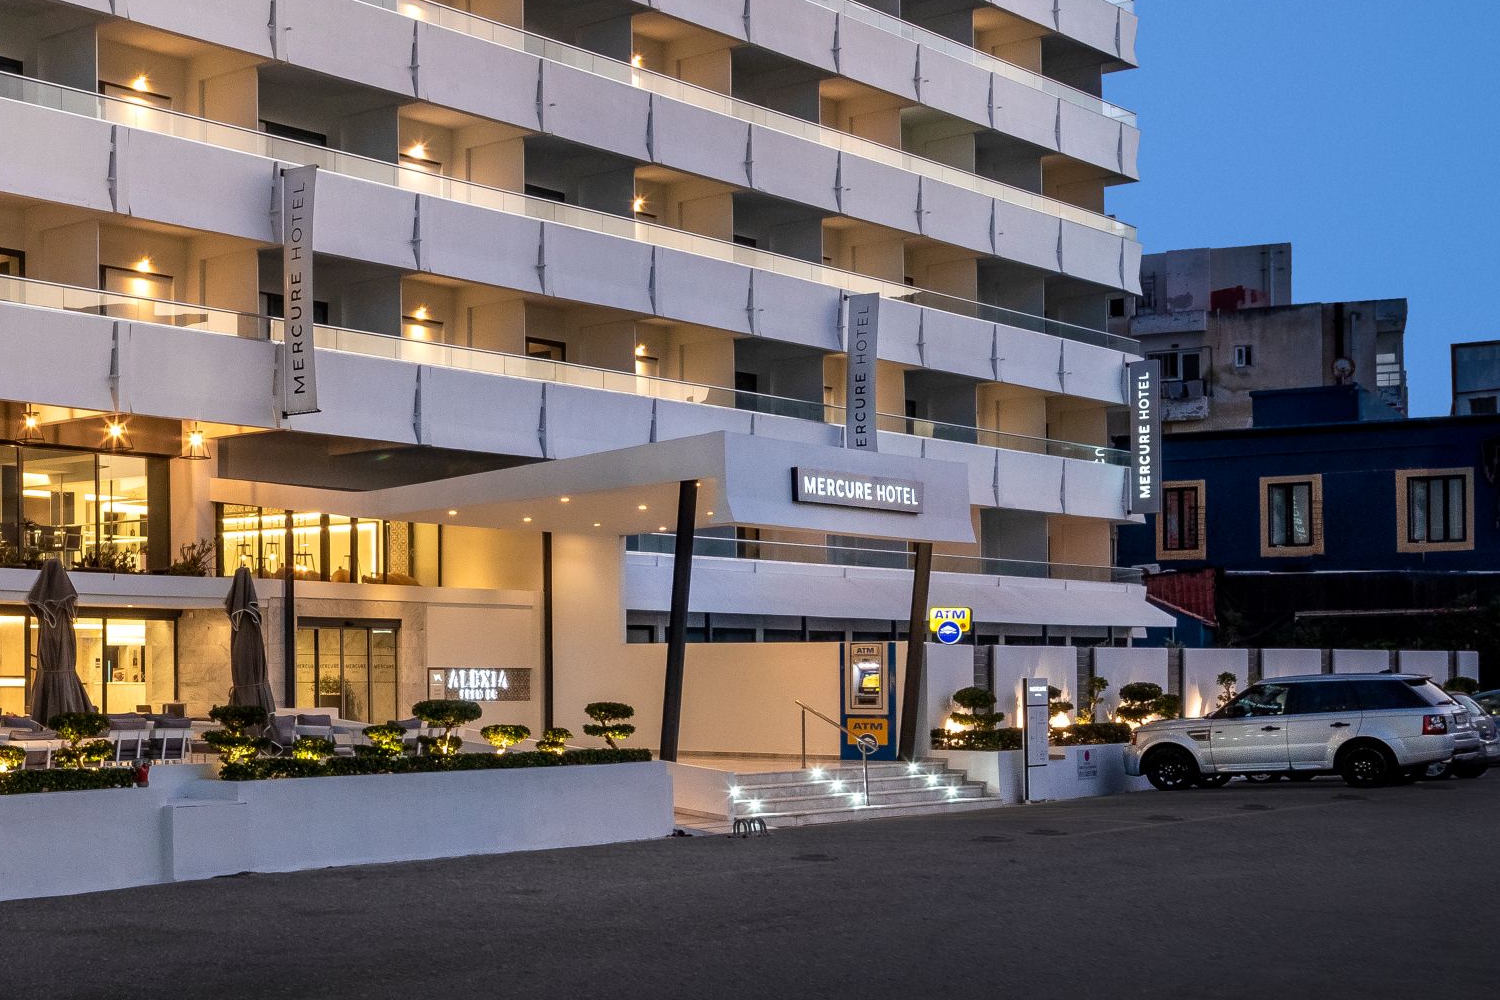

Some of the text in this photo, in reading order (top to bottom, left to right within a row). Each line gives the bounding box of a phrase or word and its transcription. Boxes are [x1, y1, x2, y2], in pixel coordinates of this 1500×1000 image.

[291, 181, 305, 394] MERCURE HOTEL
[854, 305, 869, 447] ERCURE HOTEL
[1138, 371, 1151, 499] MERCURE HOTEL
[803, 475, 919, 505] MERCURE HOTEL
[934, 609, 966, 619] ATM
[852, 722, 883, 731] ATM
